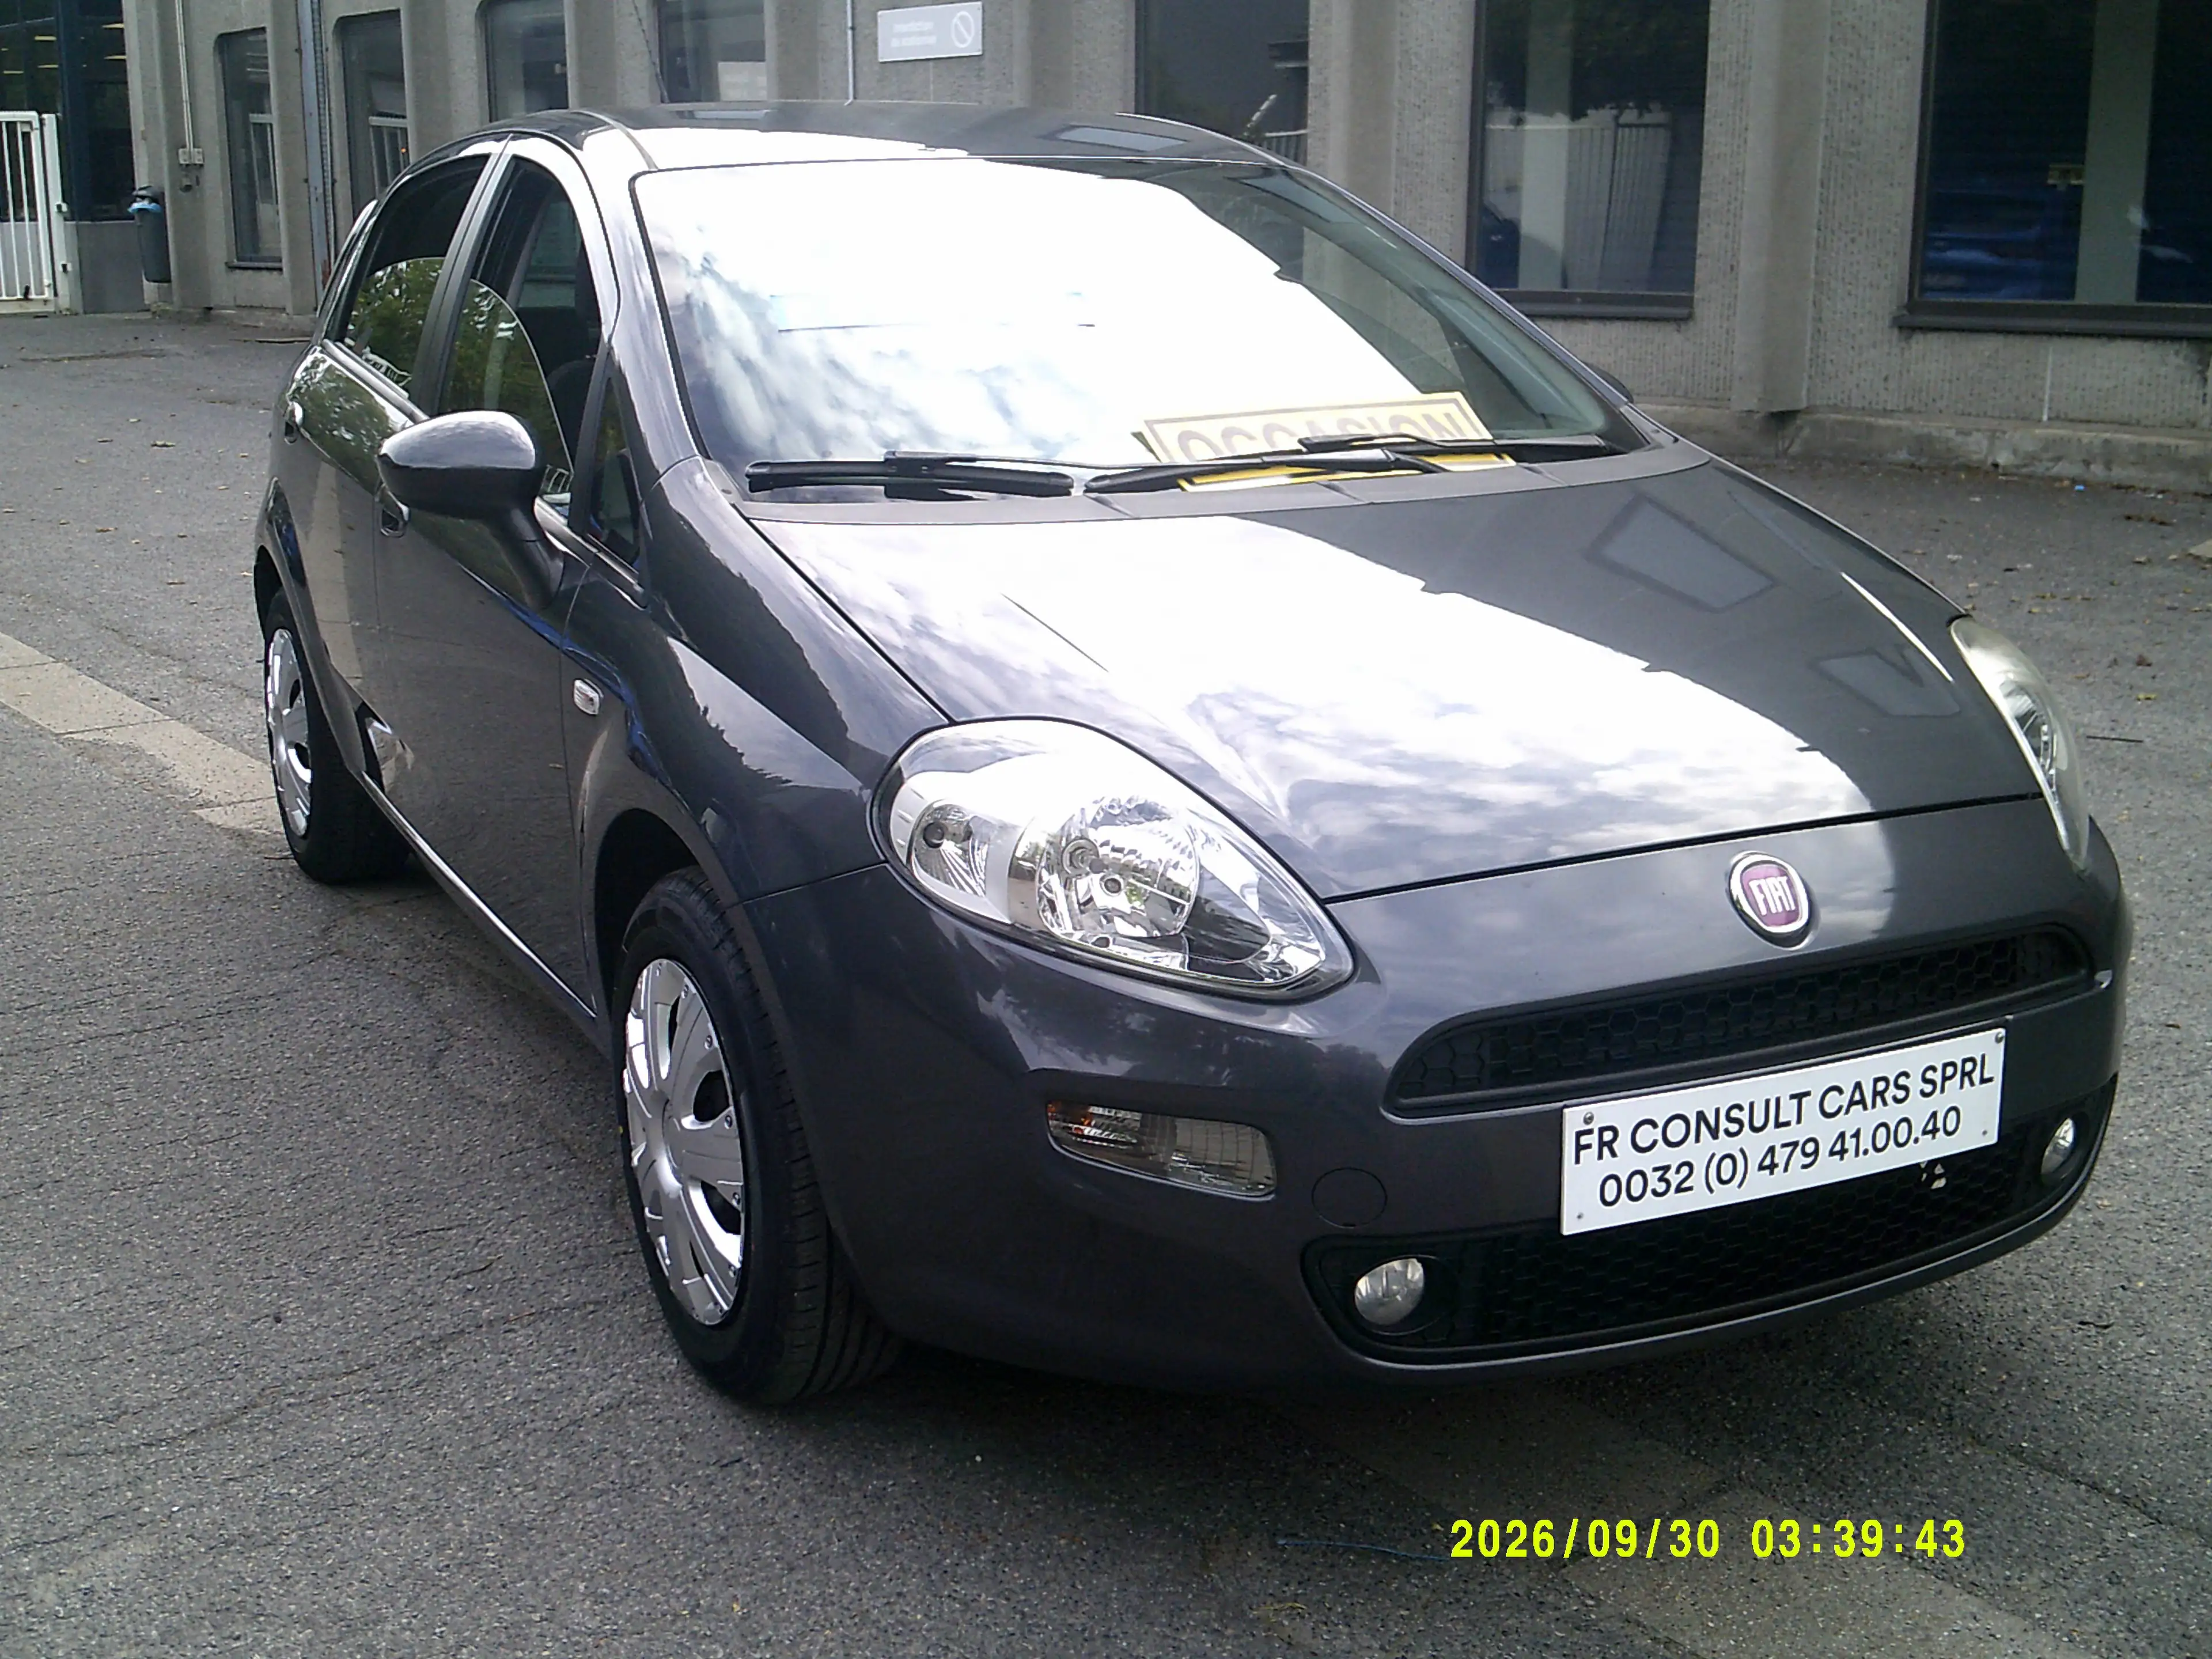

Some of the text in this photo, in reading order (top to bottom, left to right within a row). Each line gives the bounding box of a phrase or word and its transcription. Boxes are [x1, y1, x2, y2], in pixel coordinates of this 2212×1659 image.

[1748, 876, 1796, 916] FIAT
[1574, 1053, 1995, 1165] FR CONSULT CARS SPRL
[1599, 1105, 1961, 1207] 0032 (0) 479 41.00.40
